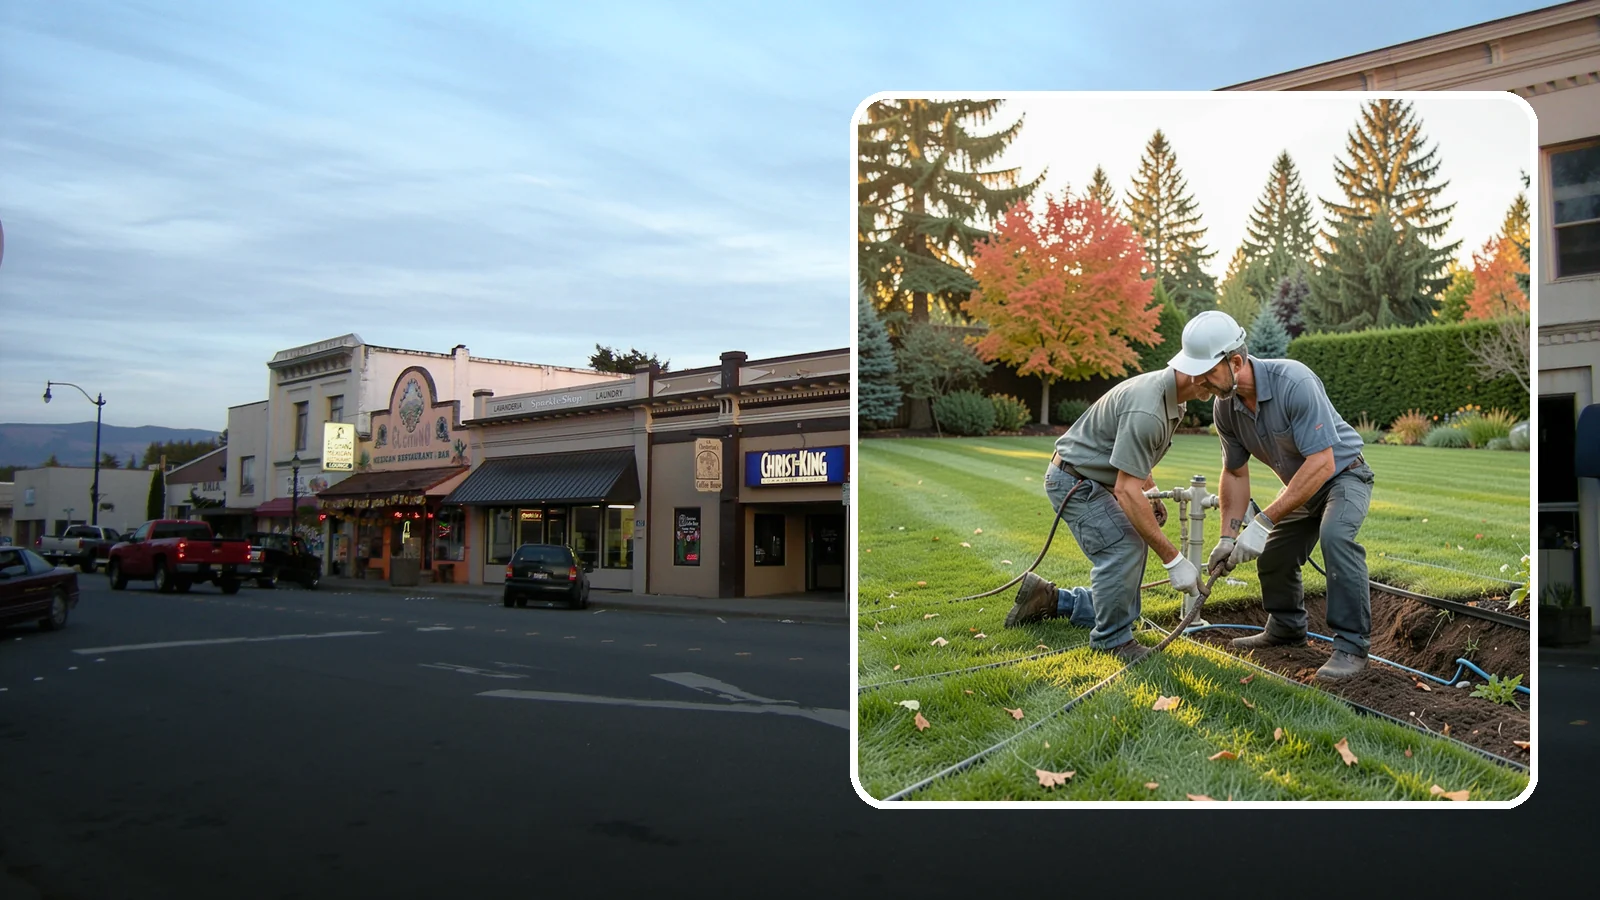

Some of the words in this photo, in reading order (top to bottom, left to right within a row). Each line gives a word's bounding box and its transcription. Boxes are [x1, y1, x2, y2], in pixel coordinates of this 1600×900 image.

[595, 389, 624, 400] LAUNDRY
[493, 402, 523, 412] LAVANDERIA
[373, 455, 396, 463] MEXICAN
[398, 451, 433, 462] RESTAURANT
[437, 450, 450, 459] BAR
[761, 452, 797, 478] CHRIST
[799, 450, 827, 476] KING
[697, 481, 709, 489] Coffee
[710, 481, 722, 489] House
